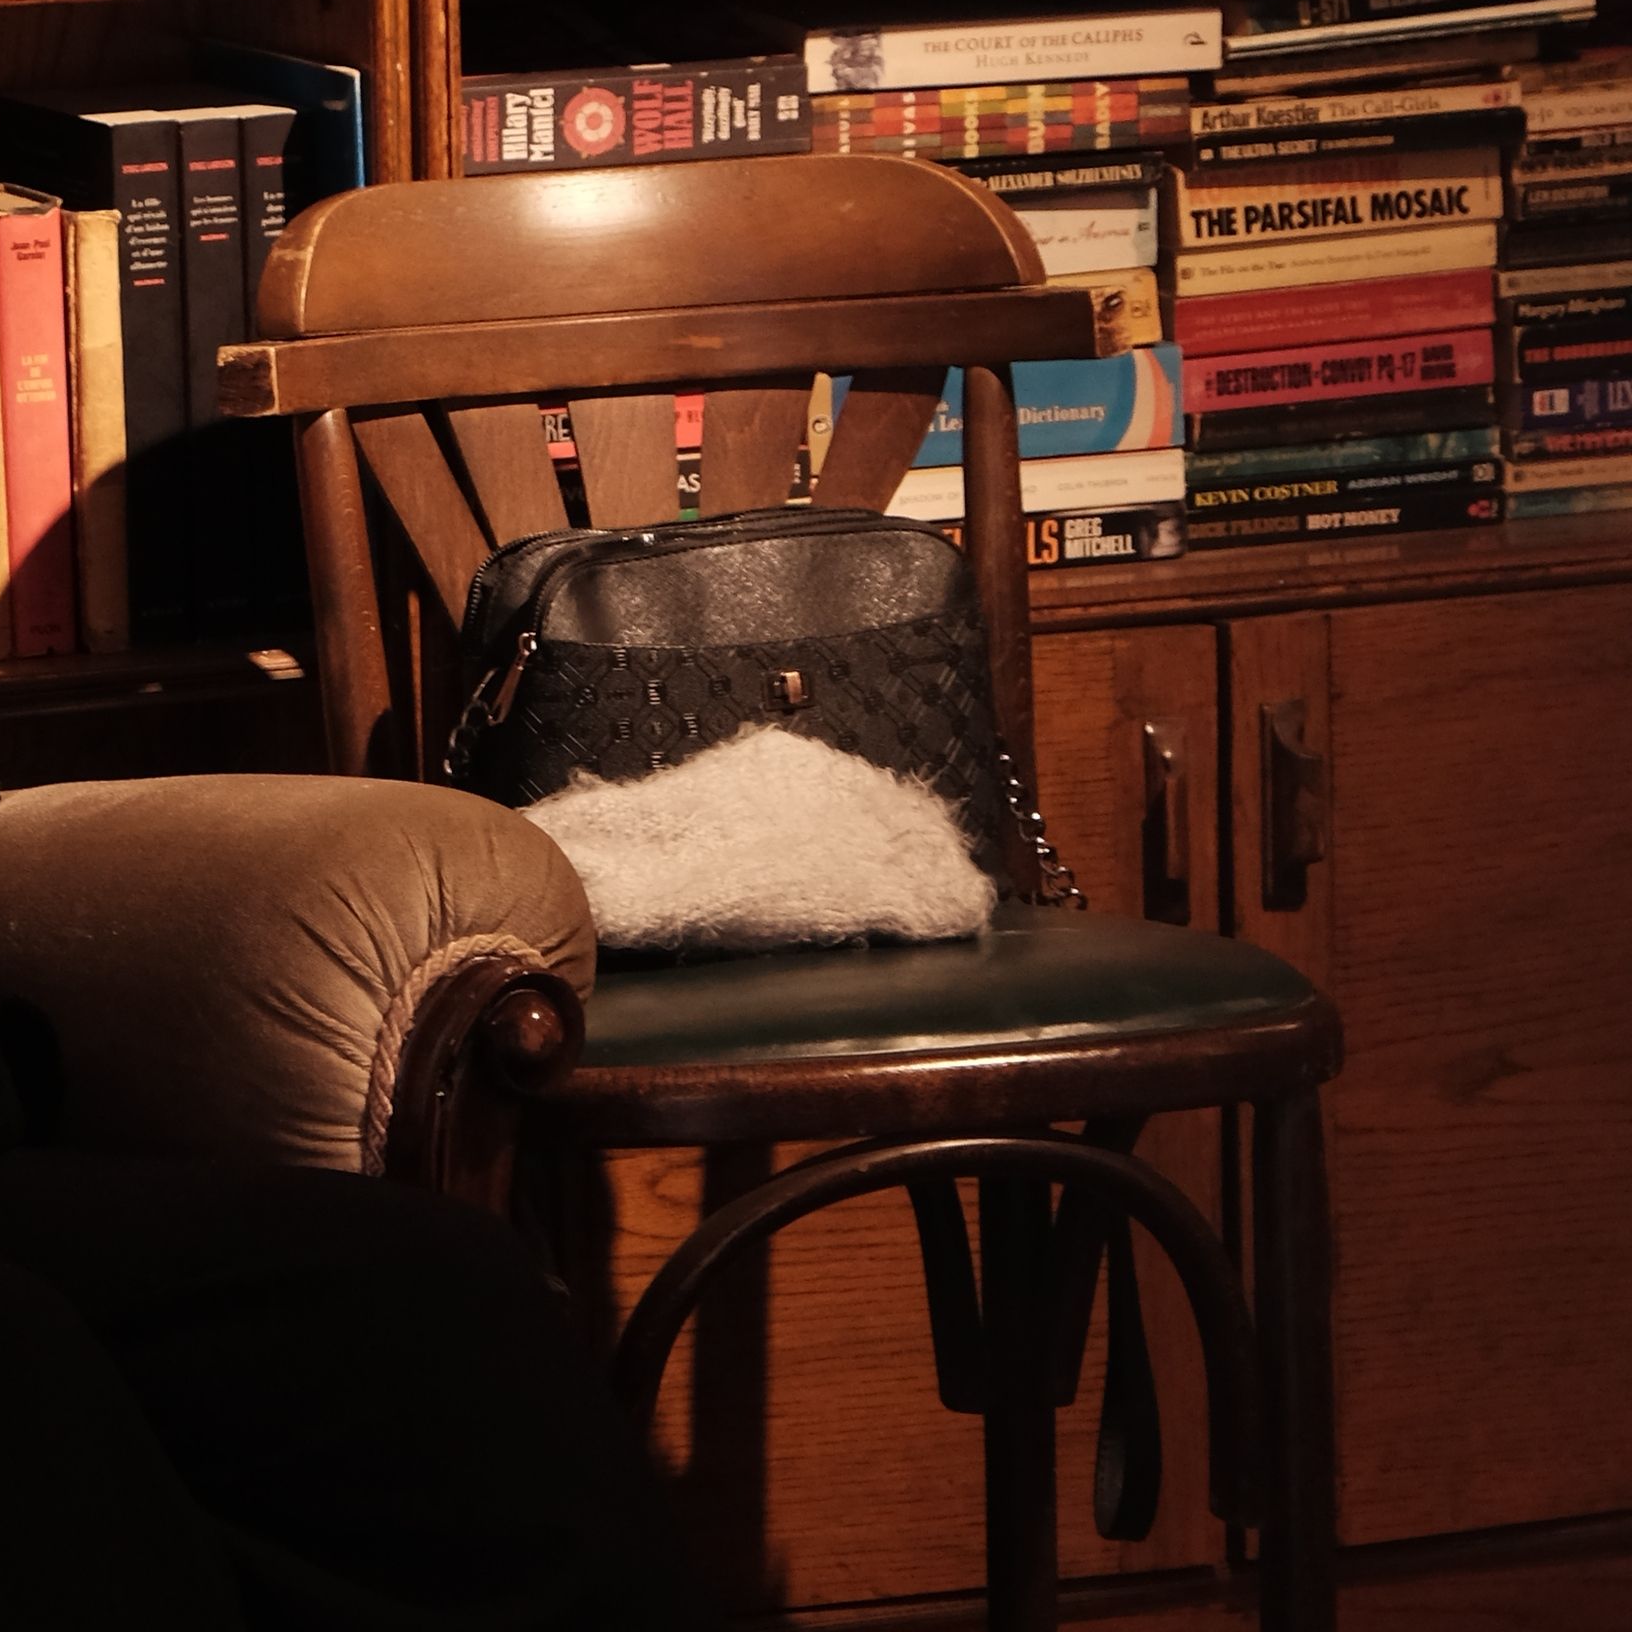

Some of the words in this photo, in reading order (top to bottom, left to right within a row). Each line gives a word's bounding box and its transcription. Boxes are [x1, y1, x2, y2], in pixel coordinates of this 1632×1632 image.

[923, 39, 952, 55] THE
[954, 35, 1013, 53] COURT
[1019, 35, 1039, 48] OF
[1040, 32, 1069, 47] THE
[1071, 28, 1145, 45] CALIPHS
[975, 52, 1021, 70] HUGH
[1025, 50, 1090, 67] KENNEDY
[501, 92, 531, 161] Hilary
[528, 87, 556, 163] Mantel
[631, 79, 664, 156] WOLF
[662, 79, 695, 150] HALL
[963, 90, 981, 159] BOOKS
[1025, 83, 1046, 155] BURN
[1094, 81, 1112, 150] BADLY
[1200, 107, 1251, 129] Arthur
[1256, 102, 1320, 127] Koestler
[1329, 102, 1358, 119] The
[1190, 207, 1237, 238] THE
[1243, 196, 1364, 235] PARSIFAL
[1369, 185, 1471, 223] MOSAIC
[1216, 361, 1313, 397] DESTRUCTION
[1017, 403, 1106, 427] Dictionary
[1194, 487, 1251, 508] KEVIN
[1253, 479, 1339, 503] COSTNER
[1064, 517, 1104, 539] GREG
[1063, 533, 1137, 560] MITCHELL
